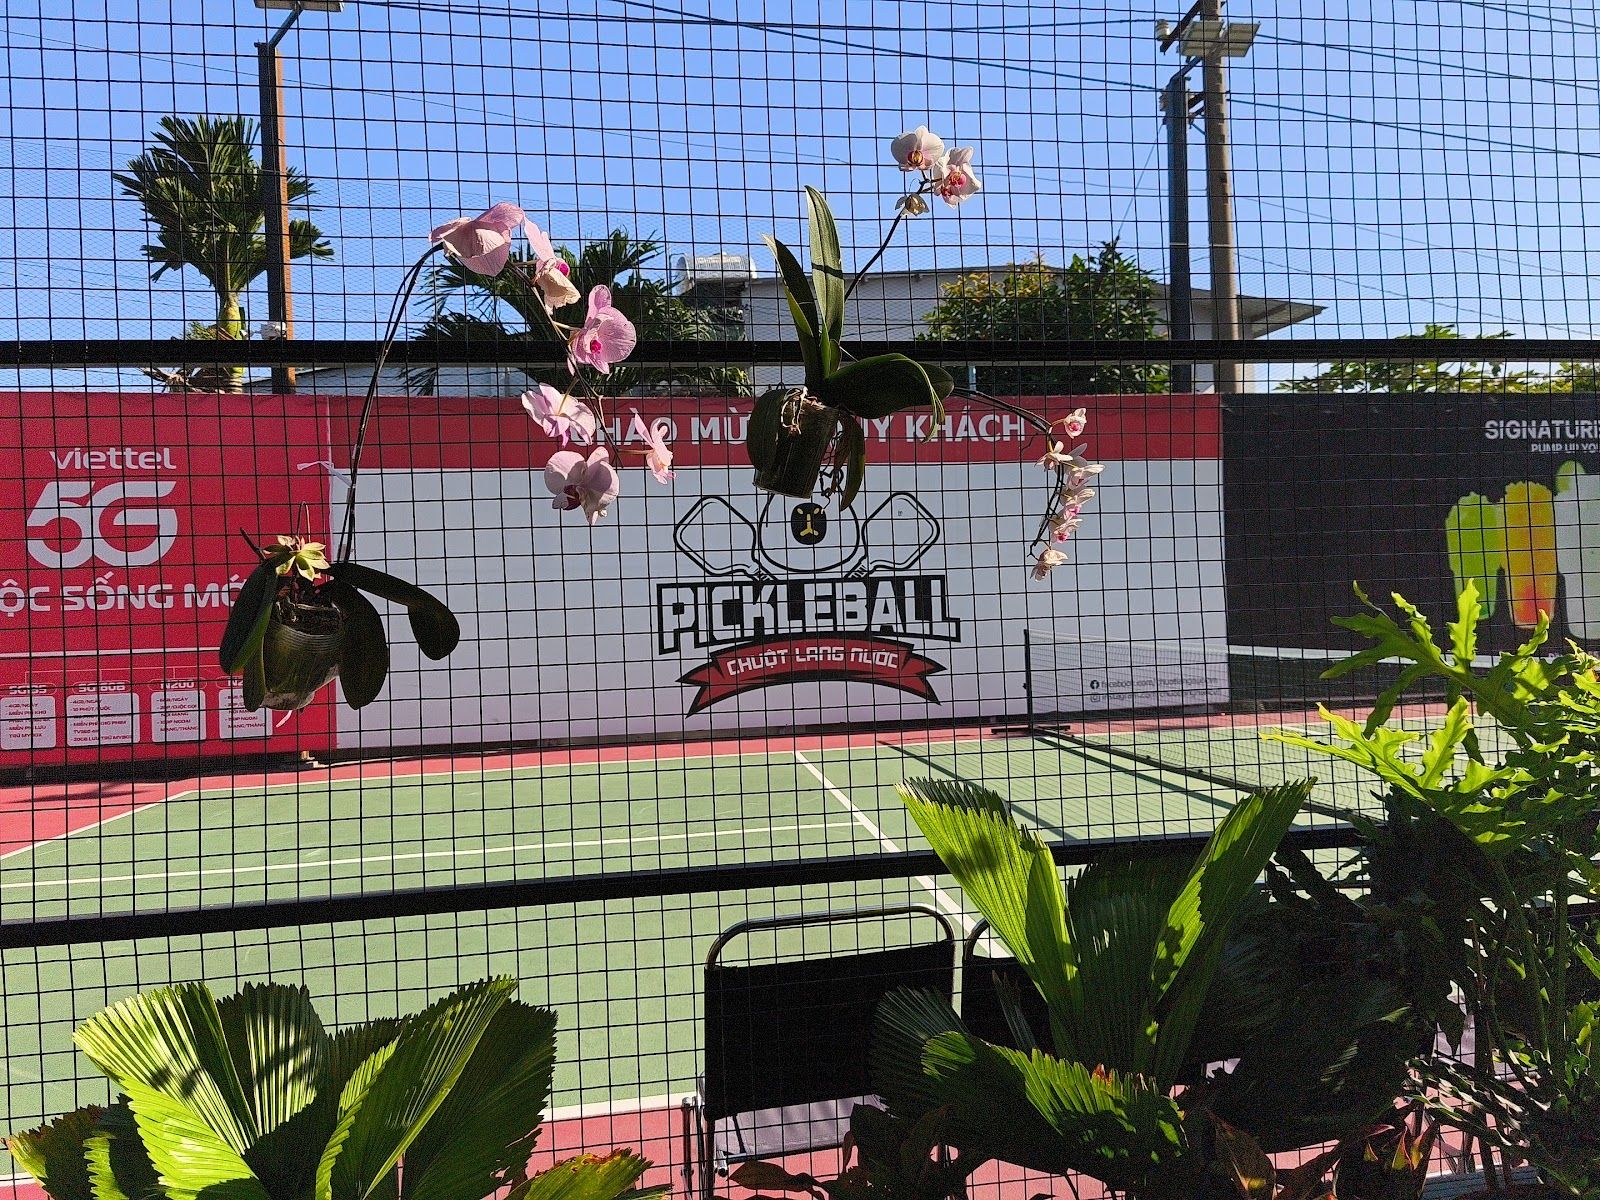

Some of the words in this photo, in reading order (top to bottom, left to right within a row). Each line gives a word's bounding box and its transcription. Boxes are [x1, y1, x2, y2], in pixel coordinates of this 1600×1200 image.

[691, 407, 752, 445] MỪ
[905, 406, 1026, 443] KHÁCH
[49, 447, 177, 470] viettel
[27, 481, 178, 569] 5G
[61, 571, 174, 611] SỐNG
[184, 574, 247, 608] MỚ
[657, 576, 960, 654] PICKLEBALL
[727, 649, 789, 676] CHUỘT
